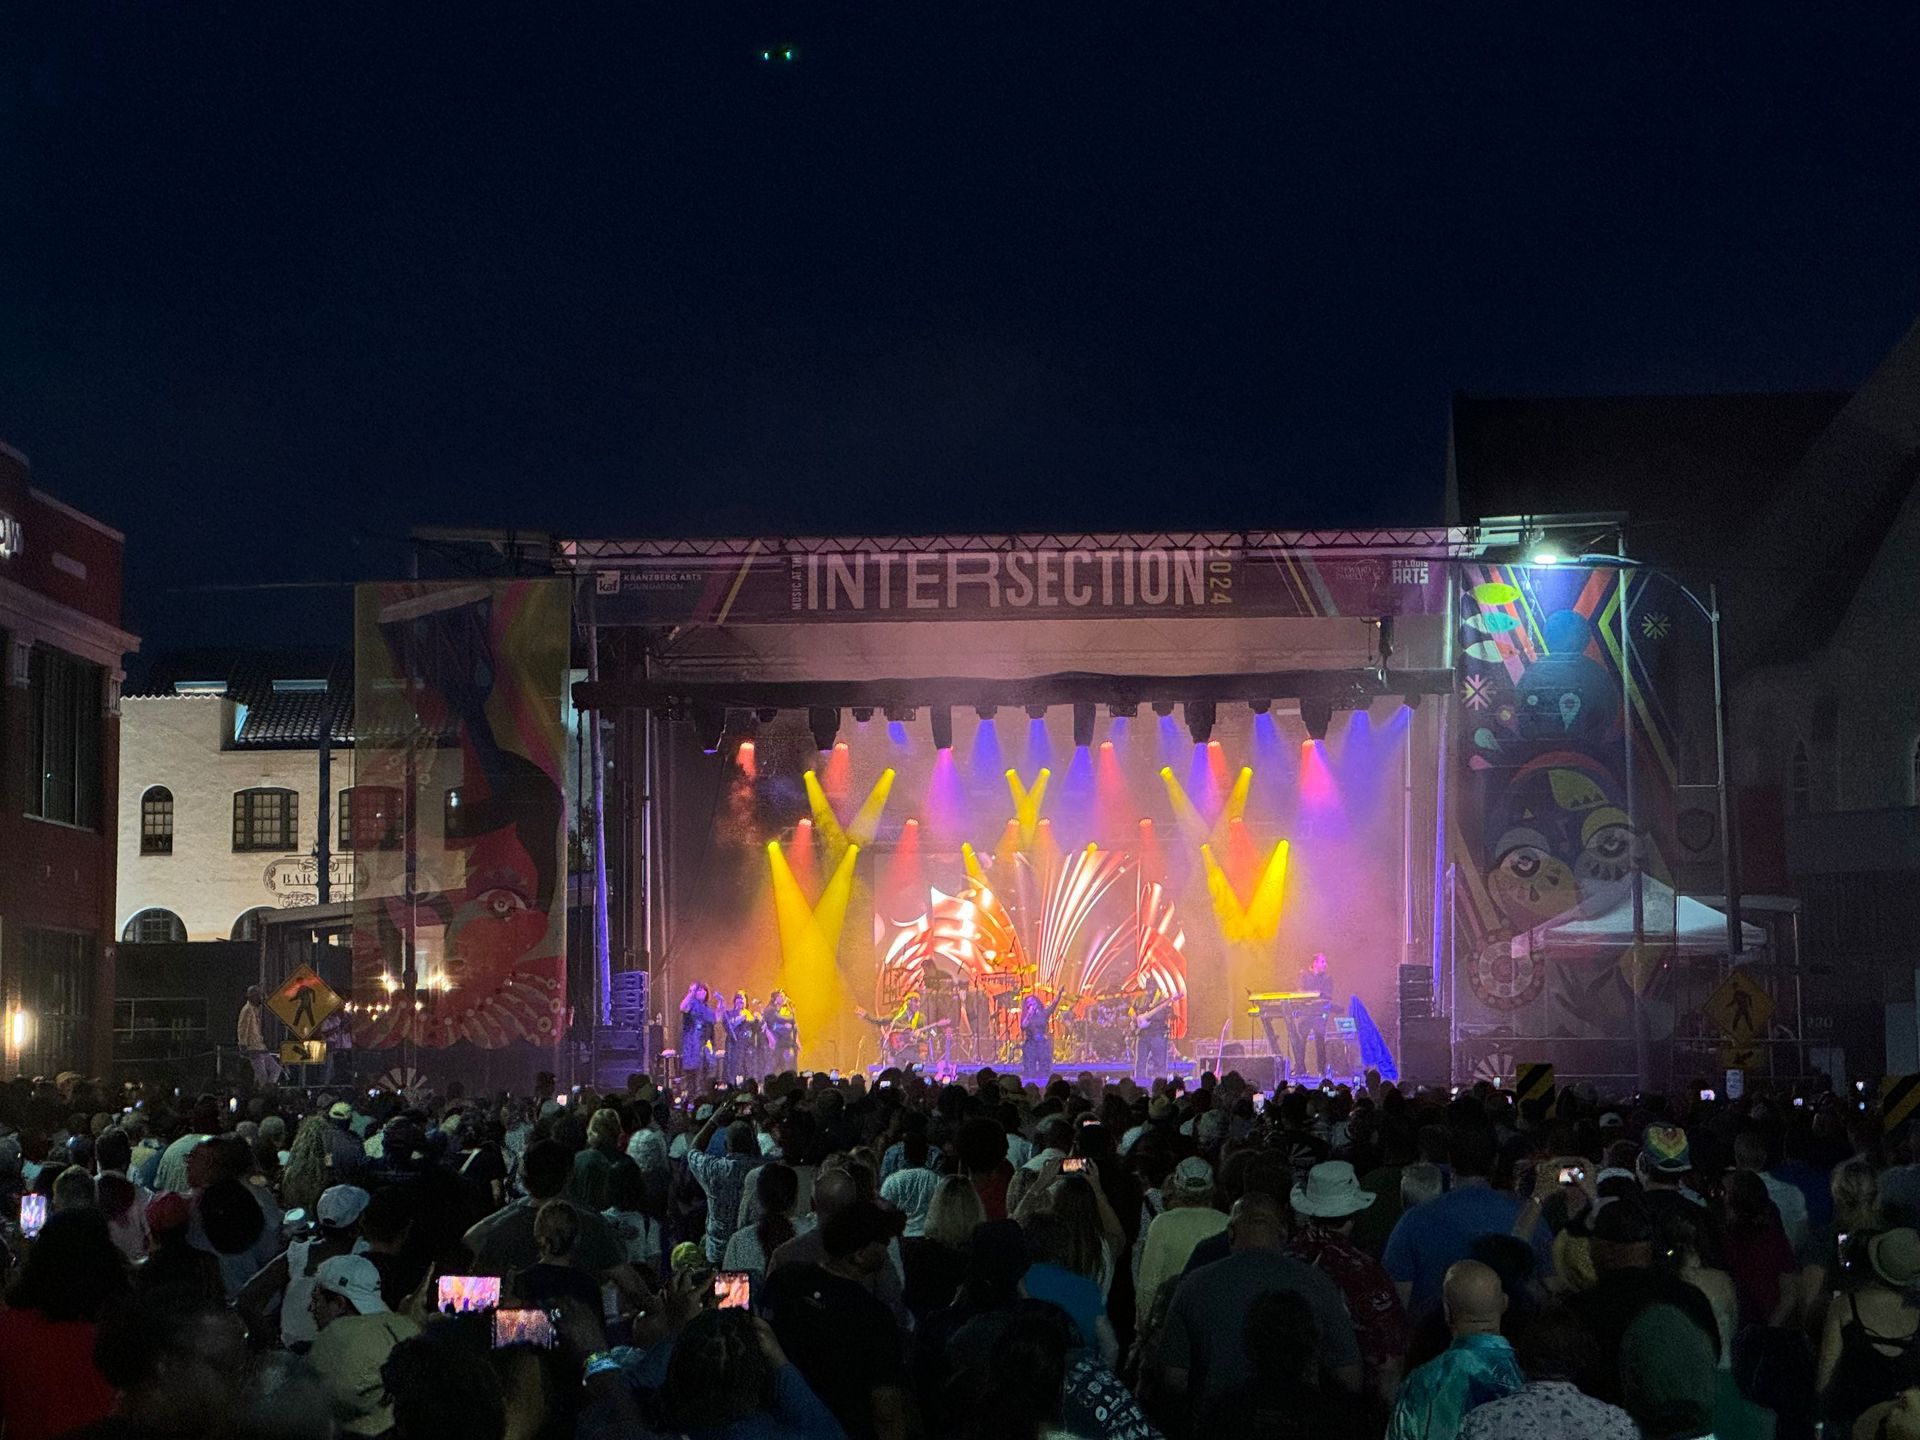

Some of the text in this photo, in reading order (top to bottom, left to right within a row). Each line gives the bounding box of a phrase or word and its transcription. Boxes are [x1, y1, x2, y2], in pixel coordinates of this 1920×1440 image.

[1405, 559, 1429, 567] LOUIS
[679, 573, 702, 581] ARTS
[791, 570, 802, 580] AT
[807, 549, 1205, 610] INTERSECTION
[1209, 549, 1233, 605] 2024
[1392, 567, 1429, 584] ARTS
[791, 582, 802, 610] MUSIC
